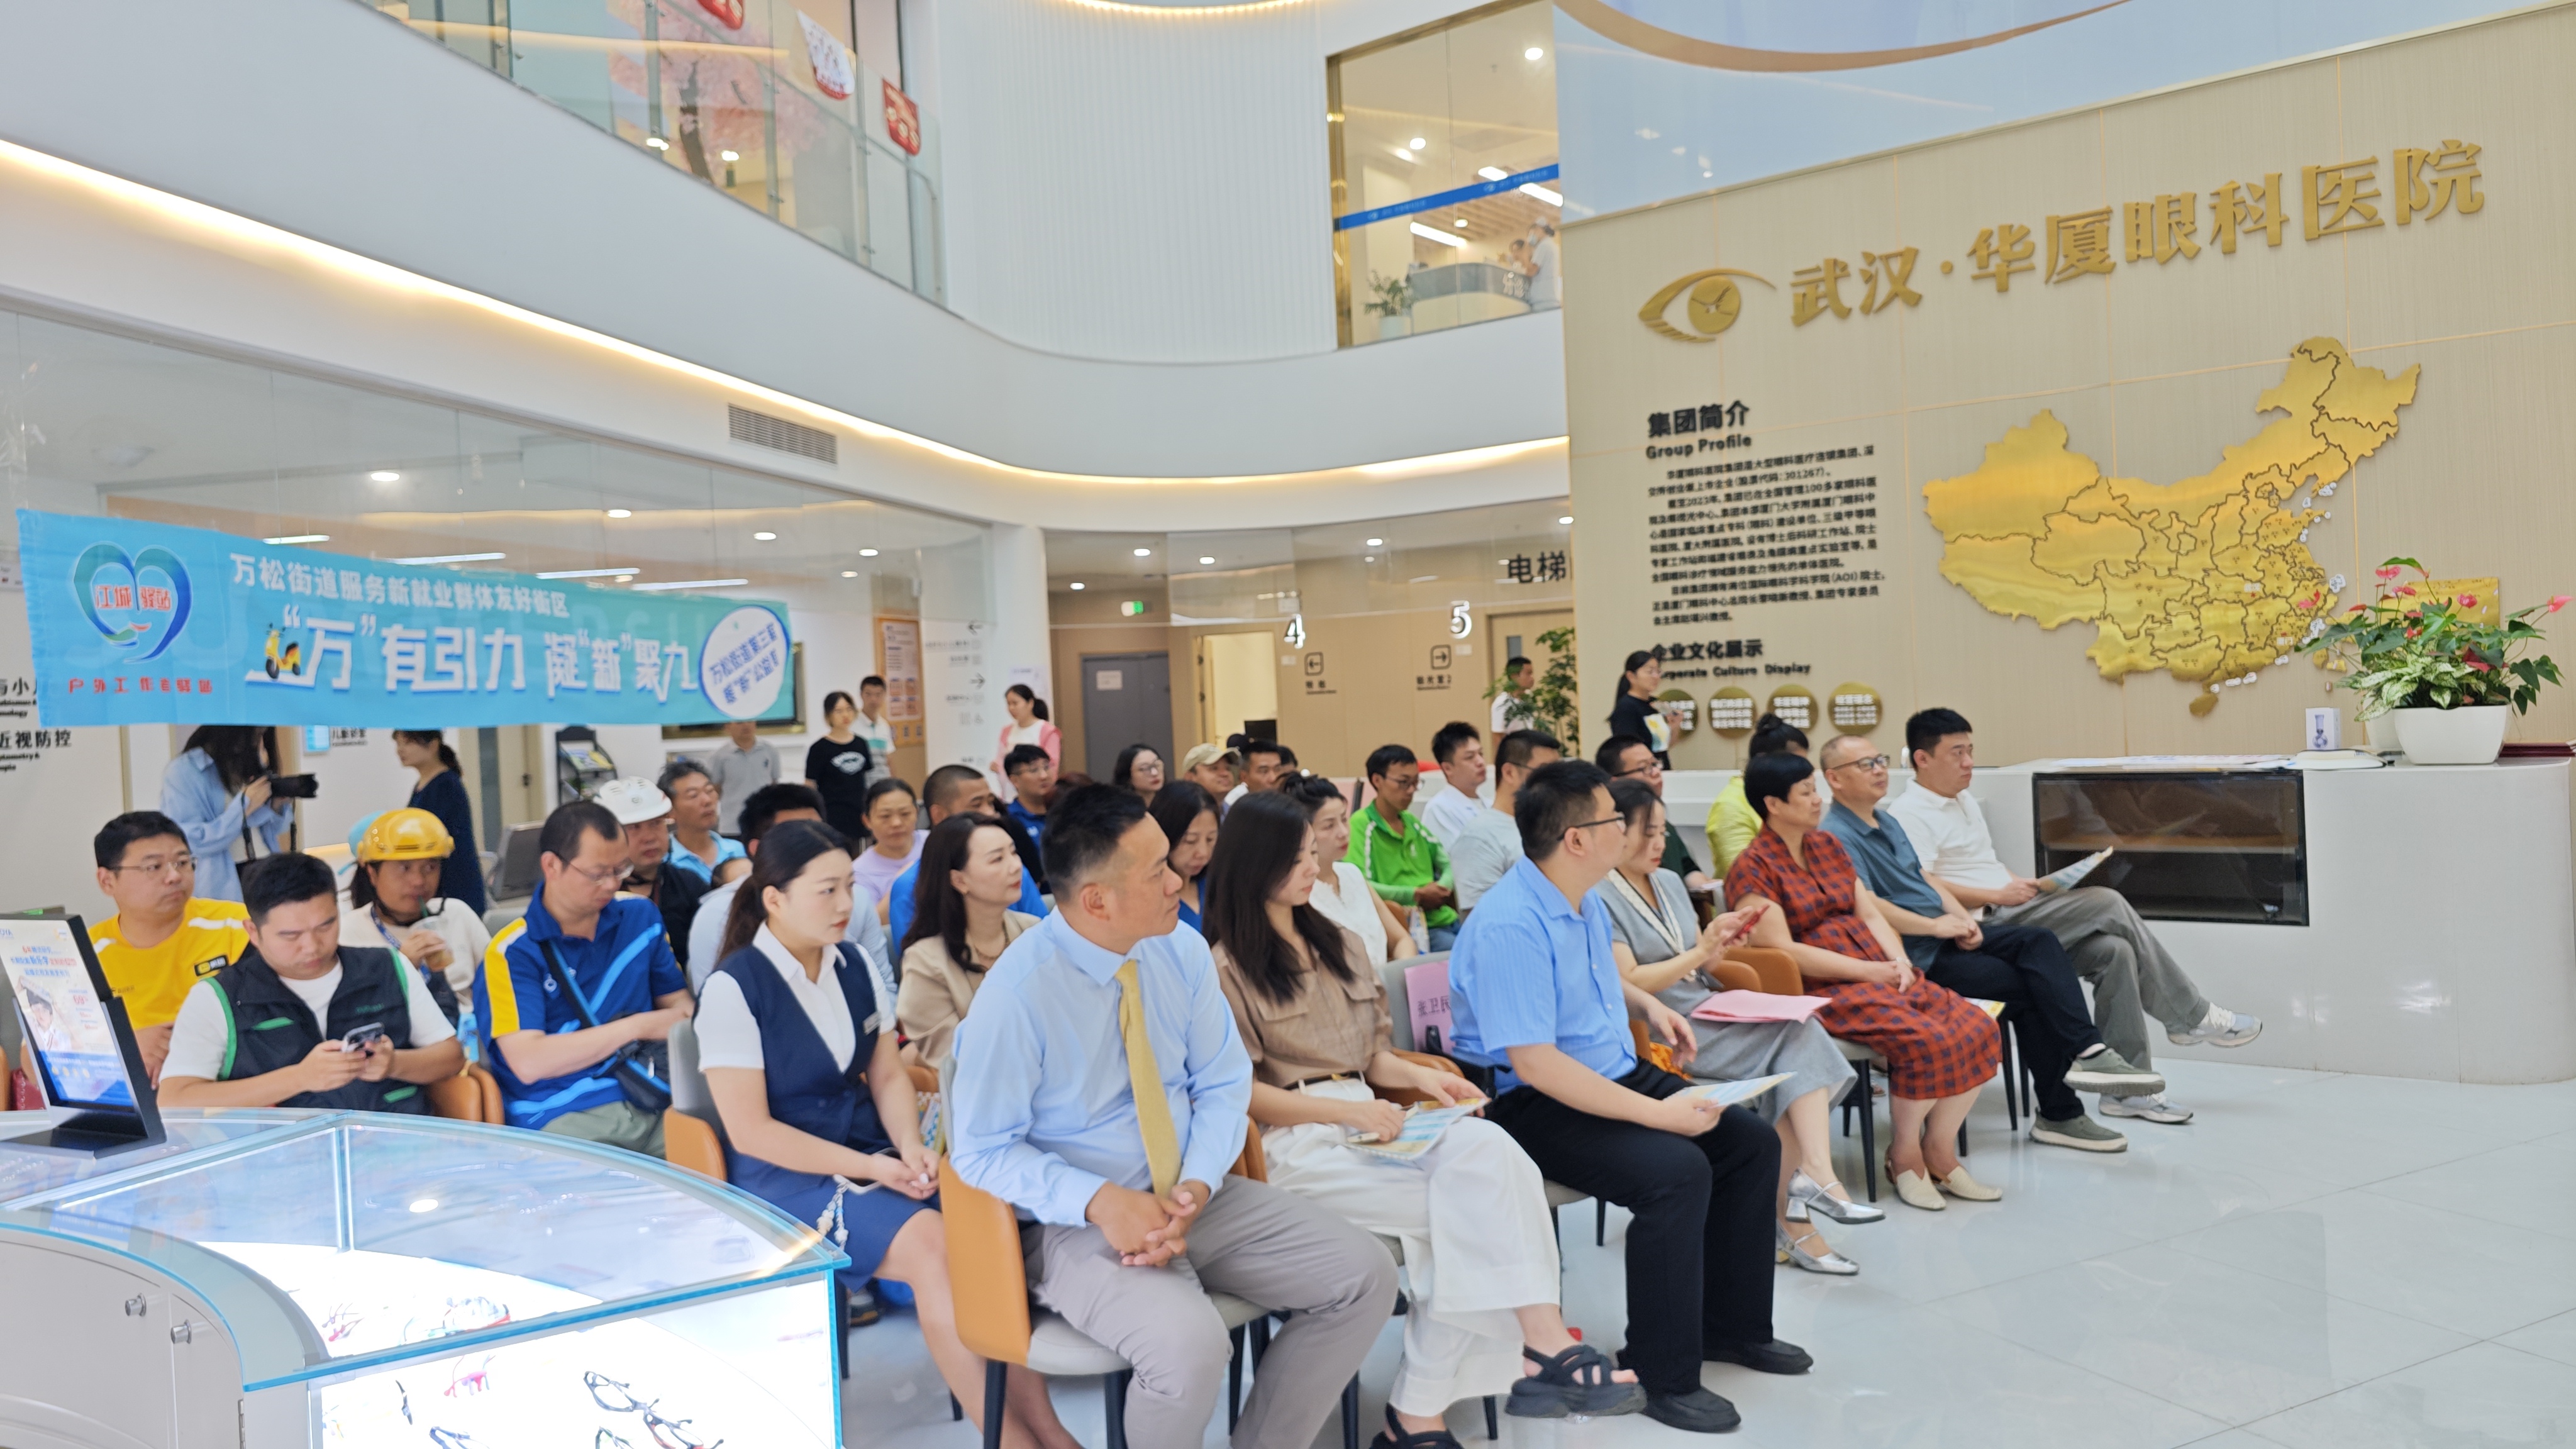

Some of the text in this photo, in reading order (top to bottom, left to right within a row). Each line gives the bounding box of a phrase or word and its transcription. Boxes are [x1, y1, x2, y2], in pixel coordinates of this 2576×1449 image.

[1790, 140, 2485, 328] 武汉·华厦眼科医院
[1647, 400, 1750, 438] 集团简介
[1646, 434, 1752, 460] Group Profile
[1507, 550, 1566, 584] 电梯
[95, 586, 172, 611] 江城 驿站
[230, 553, 569, 617] 万松街道服务新就业群体友好街区
[1284, 614, 1306, 649] 4
[1451, 600, 1473, 639] 5
[1713, 665, 1757, 677] Culture
[1765, 662, 1811, 676] Display
